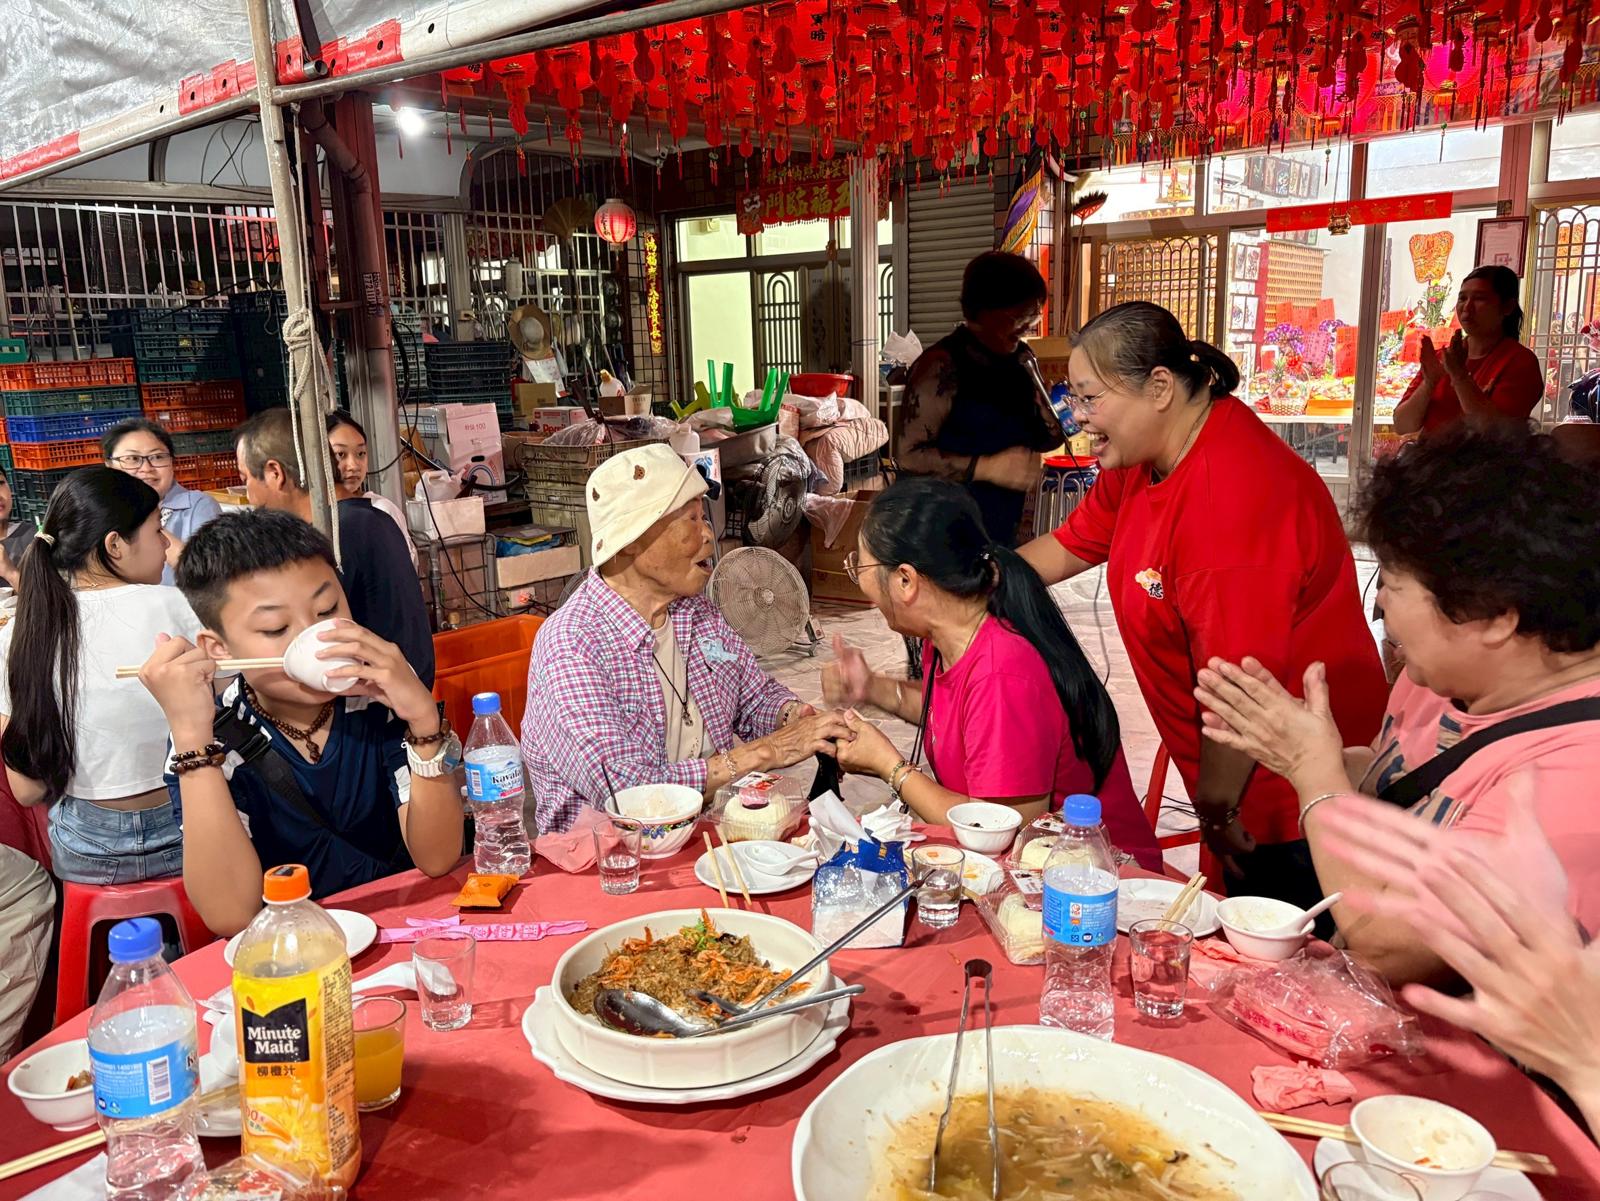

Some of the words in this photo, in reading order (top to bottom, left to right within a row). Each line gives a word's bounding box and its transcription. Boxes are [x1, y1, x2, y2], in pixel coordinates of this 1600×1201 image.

[492, 769, 522, 784] Kavala
[247, 1025, 302, 1040] Minute
[254, 1039, 295, 1055] Maid
[257, 1065, 296, 1077] 柳橙汁
